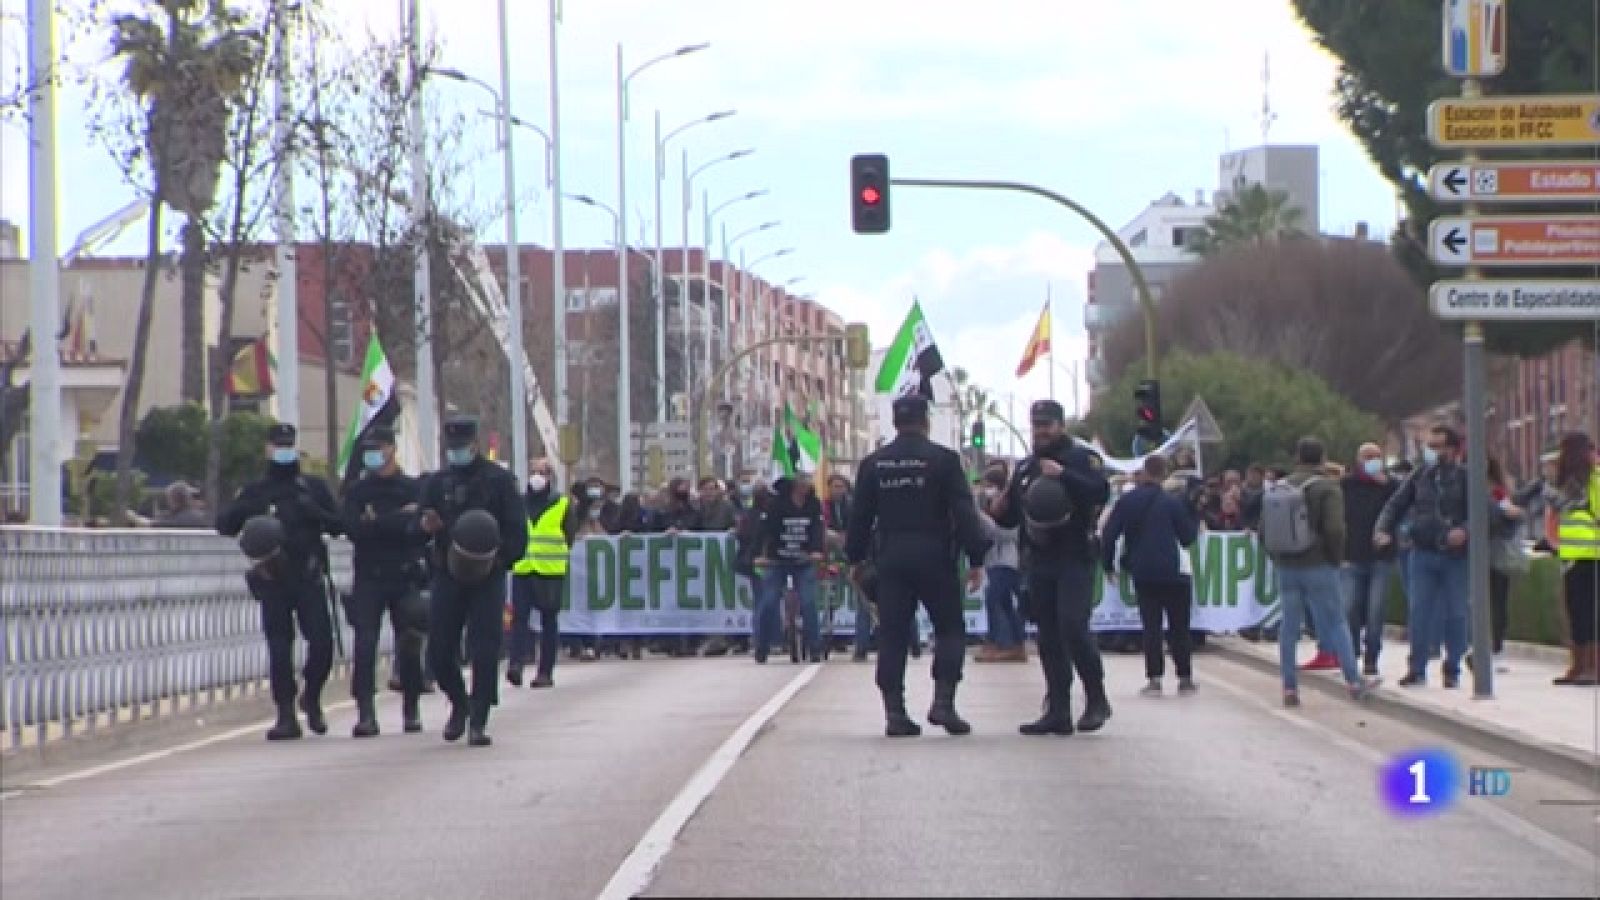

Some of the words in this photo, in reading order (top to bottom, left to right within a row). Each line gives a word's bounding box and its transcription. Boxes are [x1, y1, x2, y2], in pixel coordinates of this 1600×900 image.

[1500, 105, 1515, 121] de
[1500, 125, 1515, 139] de
[1530, 169, 1591, 189] Estadio
[1448, 288, 1489, 308] Centro
[1495, 289, 1508, 308] de
